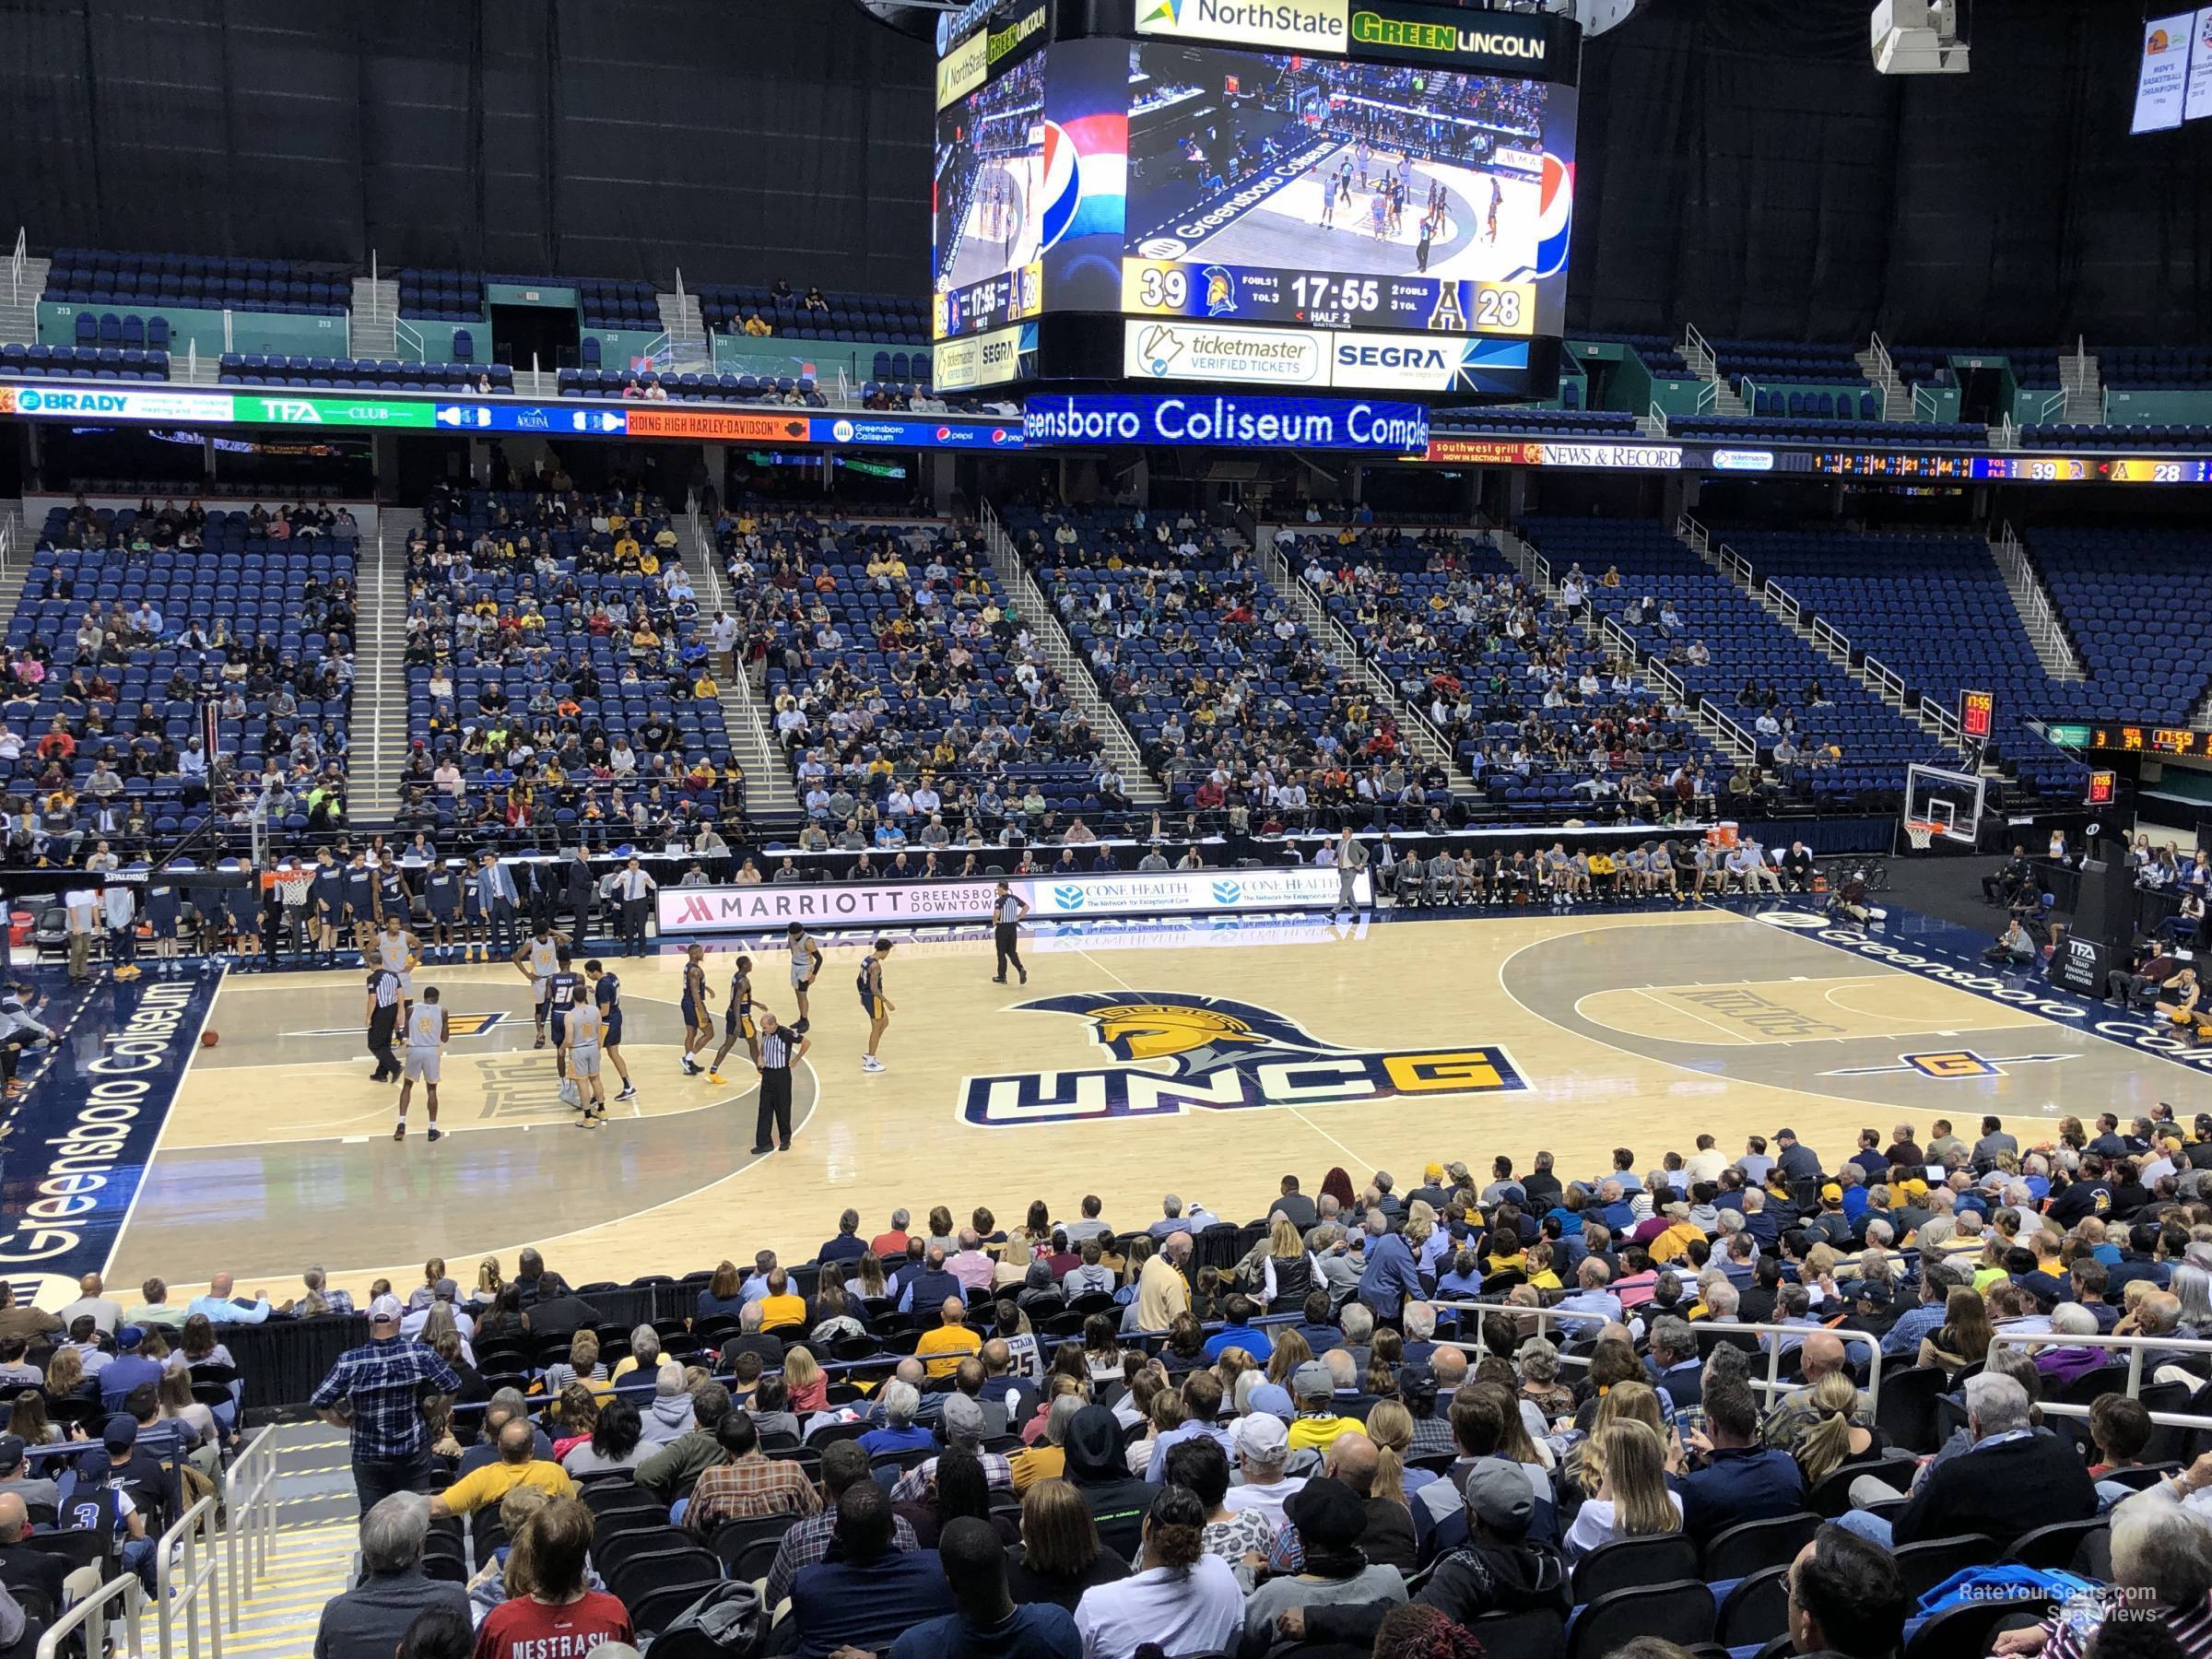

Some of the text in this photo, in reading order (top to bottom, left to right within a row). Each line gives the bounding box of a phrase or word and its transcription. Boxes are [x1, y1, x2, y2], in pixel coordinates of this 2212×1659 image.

[1199, 0, 1343, 35] NorthState
[988, 6, 1045, 65] GREEN LINCOLN
[1352, 11, 1545, 59] GREEN LINCOLN
[950, 51, 986, 88] NorthState
[1176, 141, 1338, 239] Greensboro Coliseum
[1140, 267, 1187, 309] 39
[1242, 276, 1278, 288] FOULS 1
[1253, 293, 1279, 303] TOL 3
[1292, 276, 1379, 312] 17:55
[1392, 286, 1428, 297] 2 FOULS
[57, 306, 71, 315] 213
[1391, 300, 1418, 311] 3 TOL
[1477, 289, 1521, 327] 28
[1311, 312, 1351, 323] HALF 2
[606, 334, 618, 342] 212
[982, 340, 1014, 364] SEGRA
[1193, 335, 1305, 359] ticketmaster
[1338, 346, 1445, 369] SEGRA
[1192, 358, 1300, 372] VERIFIED TICKETS
[45, 394, 127, 411] BRADY
[262, 400, 323, 422] TFA
[348, 407, 389, 420] CLUB
[629, 417, 661, 431] RIDING
[665, 418, 688, 432] HIGH
[1156, 397, 1333, 442] Coliseum
[855, 424, 904, 435] Greensboro
[855, 432, 894, 441] Coliseum
[951, 432, 973, 441] pepsi
[1008, 434, 1024, 442] pep
[1436, 443, 1519, 455] southwest grill
[1544, 446, 1681, 467] NEWS & RECORD
[1816, 456, 1821, 468] 1
[1844, 458, 1852, 469] 2
[1873, 458, 1886, 470] 14
[1905, 459, 1918, 471] 21
[1939, 461, 1953, 472] 44
[2011, 461, 2018, 470] 3
[2198, 462, 2205, 471] 3
[2031, 463, 2056, 479] 39
[2153, 465, 2181, 481] 28
[2197, 472, 2205, 481] 2
[1968, 695, 1990, 710] 17:55
[1965, 709, 1987, 733] 30
[2097, 734, 2106, 747] 3
[2125, 736, 2142, 748] 39
[2159, 732, 2193, 745] 17:55
[2177, 744, 2184, 752] 2
[2094, 776, 2111, 785] 17:55
[2094, 786, 2108, 799] 30
[105, 872, 149, 883] SPALDING
[1242, 877, 1340, 891] CONE HEALTH
[1086, 883, 1187, 897] CONE HEALTH
[721, 891, 903, 918] MARRIOTT
[911, 900, 992, 912] DOWNTOW
[1139, 898, 1174, 906] Exceptional
[2068, 940, 2096, 960] TFA
[2072, 959, 2090, 969] TRIAD
[2065, 964, 2094, 979] FINANCIAL
[2065, 973, 2092, 986] ADVISORS
[1819, 930, 2212, 1067] Greensboro Coli
[88, 981, 196, 1074] Coliseum
[970, 1051, 1516, 1121] UNCG
[0, 1080, 151, 1263] Greensboro
[74, 1502, 100, 1529] 3
